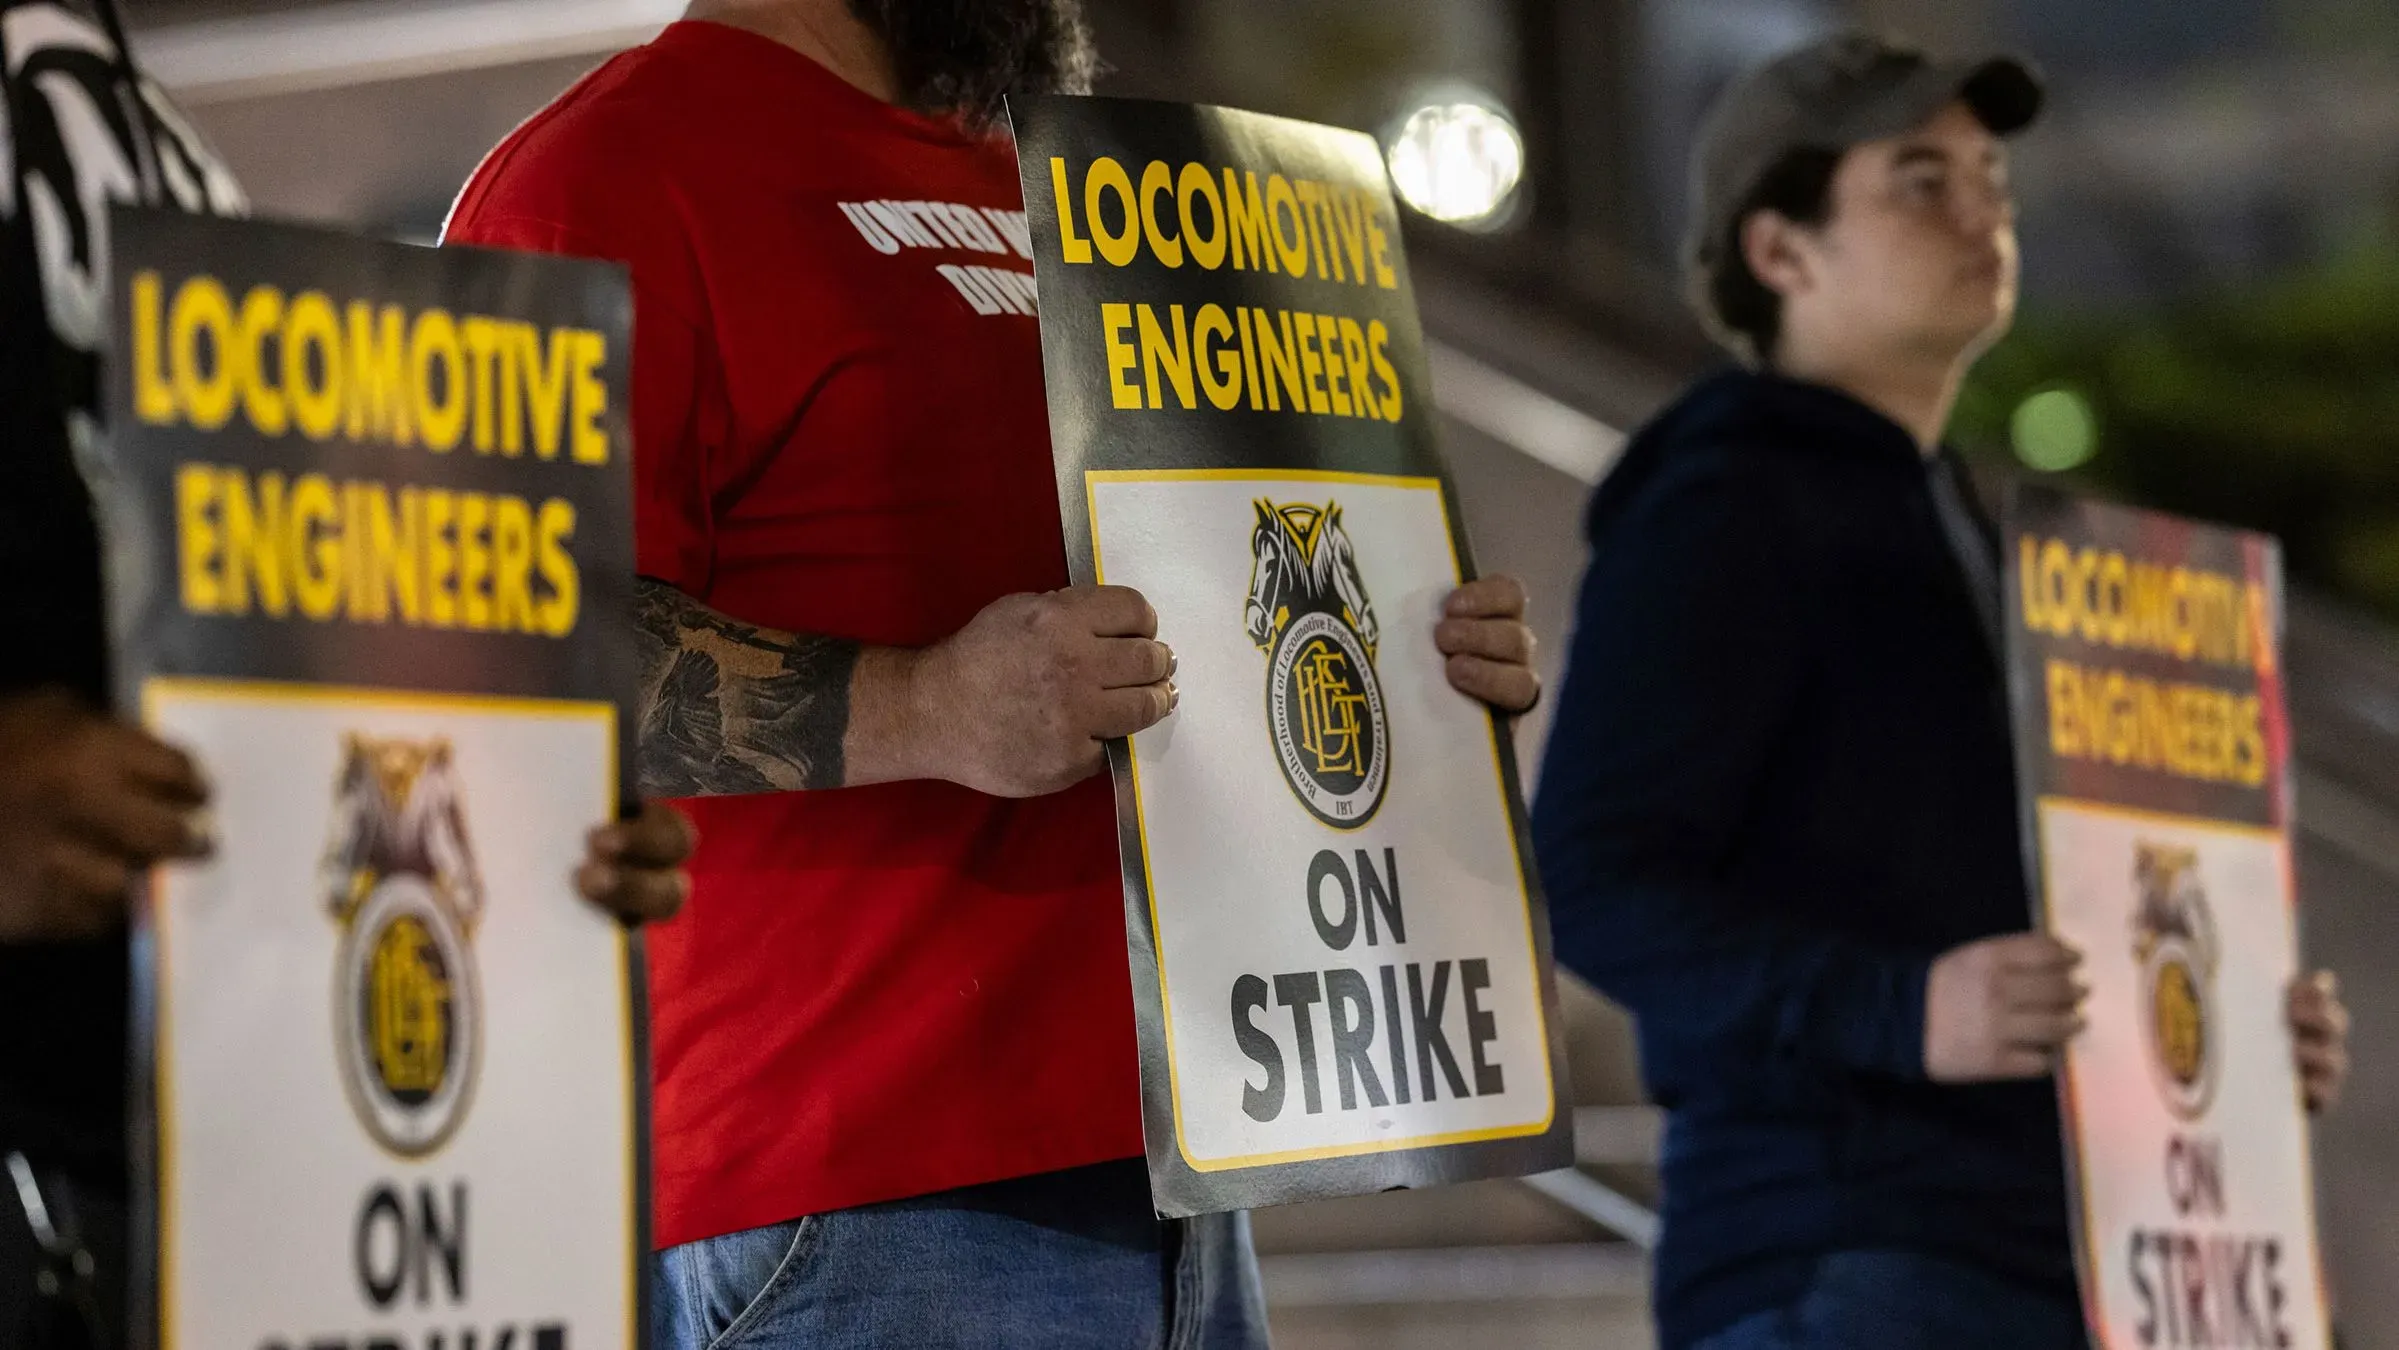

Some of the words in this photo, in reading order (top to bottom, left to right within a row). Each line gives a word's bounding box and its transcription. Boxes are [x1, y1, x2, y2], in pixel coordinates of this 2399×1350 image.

[837, 199, 1008, 255] UNITED
[1050, 156, 1397, 290] LOCOMOTIVE
[132, 269, 608, 465] LOCOMOTIVE
[1101, 302, 1403, 423] ENGINEERS
[175, 463, 580, 638] ENGINEERS
[1276, 671, 1285, 690] of
[1279, 617, 1326, 670] Locomotive
[1275, 693, 1317, 799] Brotherhood
[1307, 847, 1406, 951] ON
[1231, 957, 1505, 1123] STRIKE
[353, 1179, 469, 1311] ON
